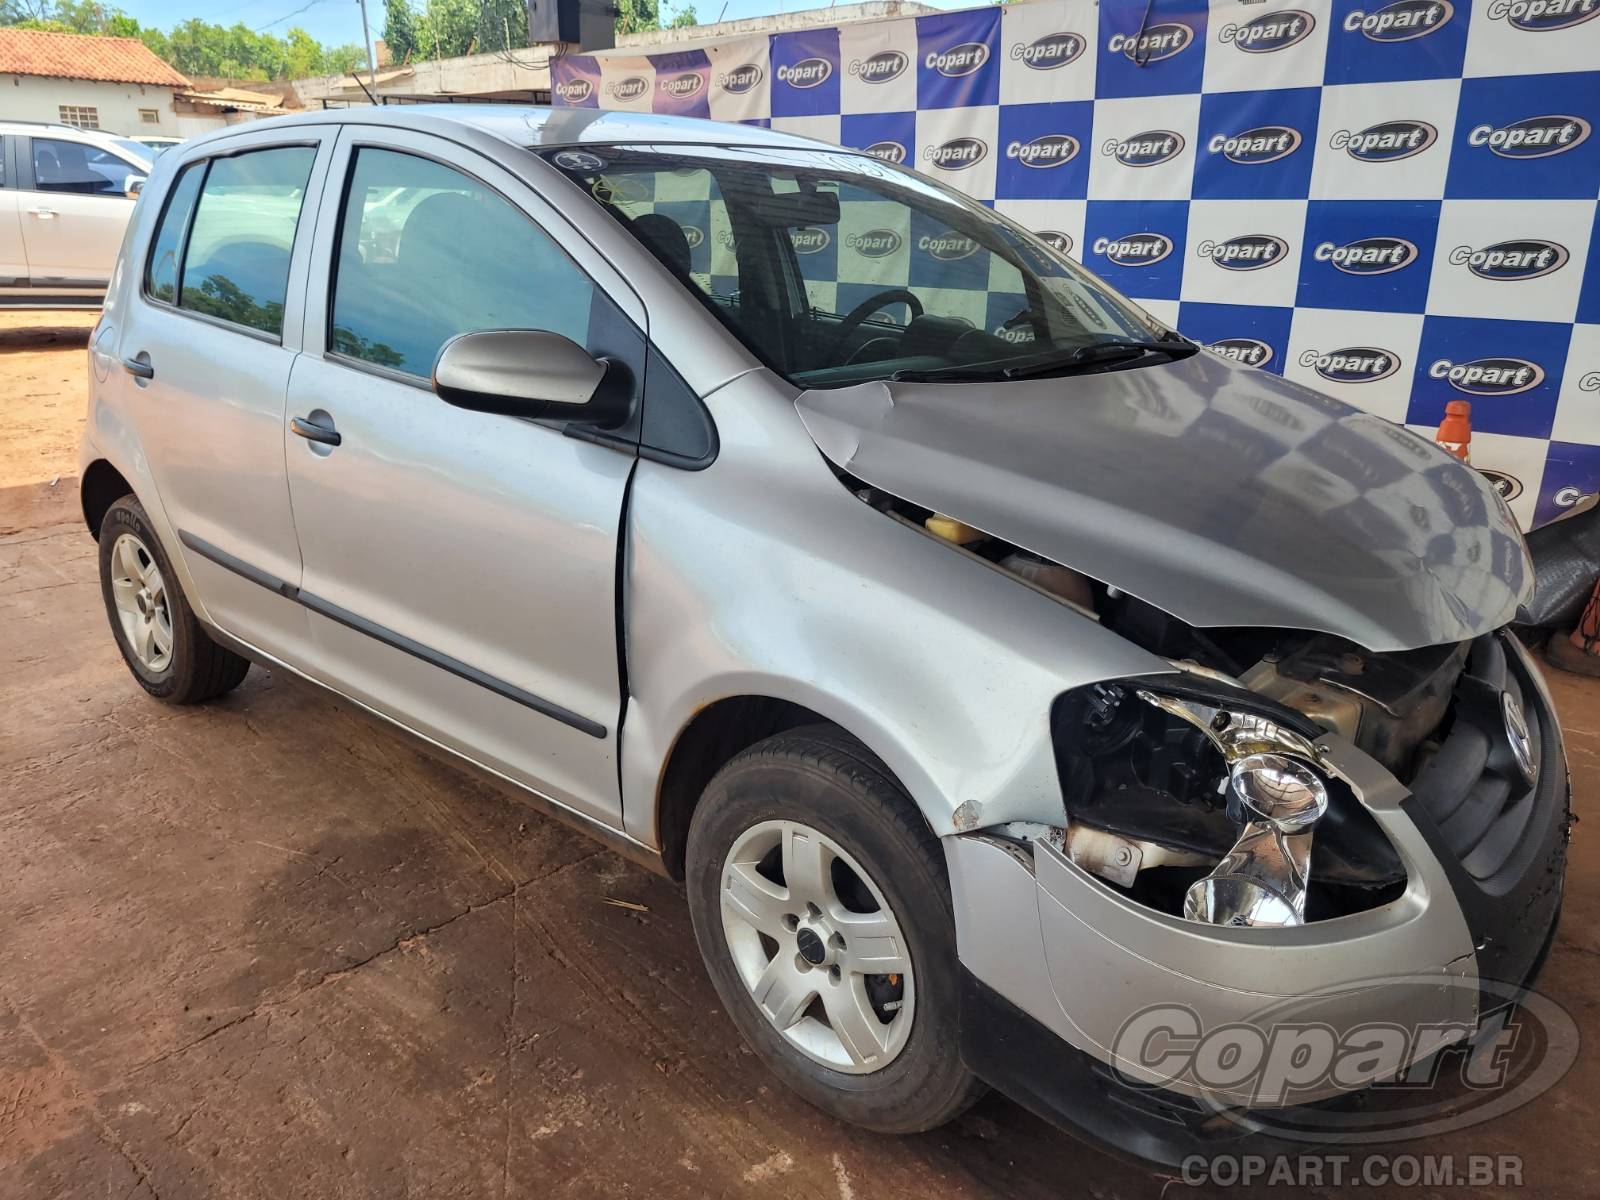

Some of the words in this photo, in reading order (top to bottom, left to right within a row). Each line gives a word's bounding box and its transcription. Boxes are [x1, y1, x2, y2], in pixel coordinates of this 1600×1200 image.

[1344, 5, 1438, 34] Copart
[1219, 17, 1300, 46] Copart
[925, 48, 982, 71] Copart
[1011, 39, 1076, 62] Copart
[777, 62, 825, 84] Copart
[849, 57, 899, 79] Copart
[605, 78, 643, 97] Copart
[661, 74, 699, 95] Copart
[715, 69, 756, 90] Copart
[556, 82, 588, 100] Copart
[1209, 132, 1288, 156] Copart
[1330, 127, 1424, 153] Copart
[1468, 120, 1576, 151] Copart
[923, 141, 977, 163] Copart
[1007, 140, 1070, 162] Copart
[1101, 138, 1174, 160] Copart
[845, 232, 894, 253] Copart
[919, 236, 975, 255] Copart
[1093, 237, 1163, 258] Copart
[1197, 240, 1279, 263] Copart
[1313, 241, 1406, 267] Copart
[1449, 245, 1552, 272] Copart
[1299, 350, 1385, 374] Copart
[1429, 360, 1533, 387] Copart
